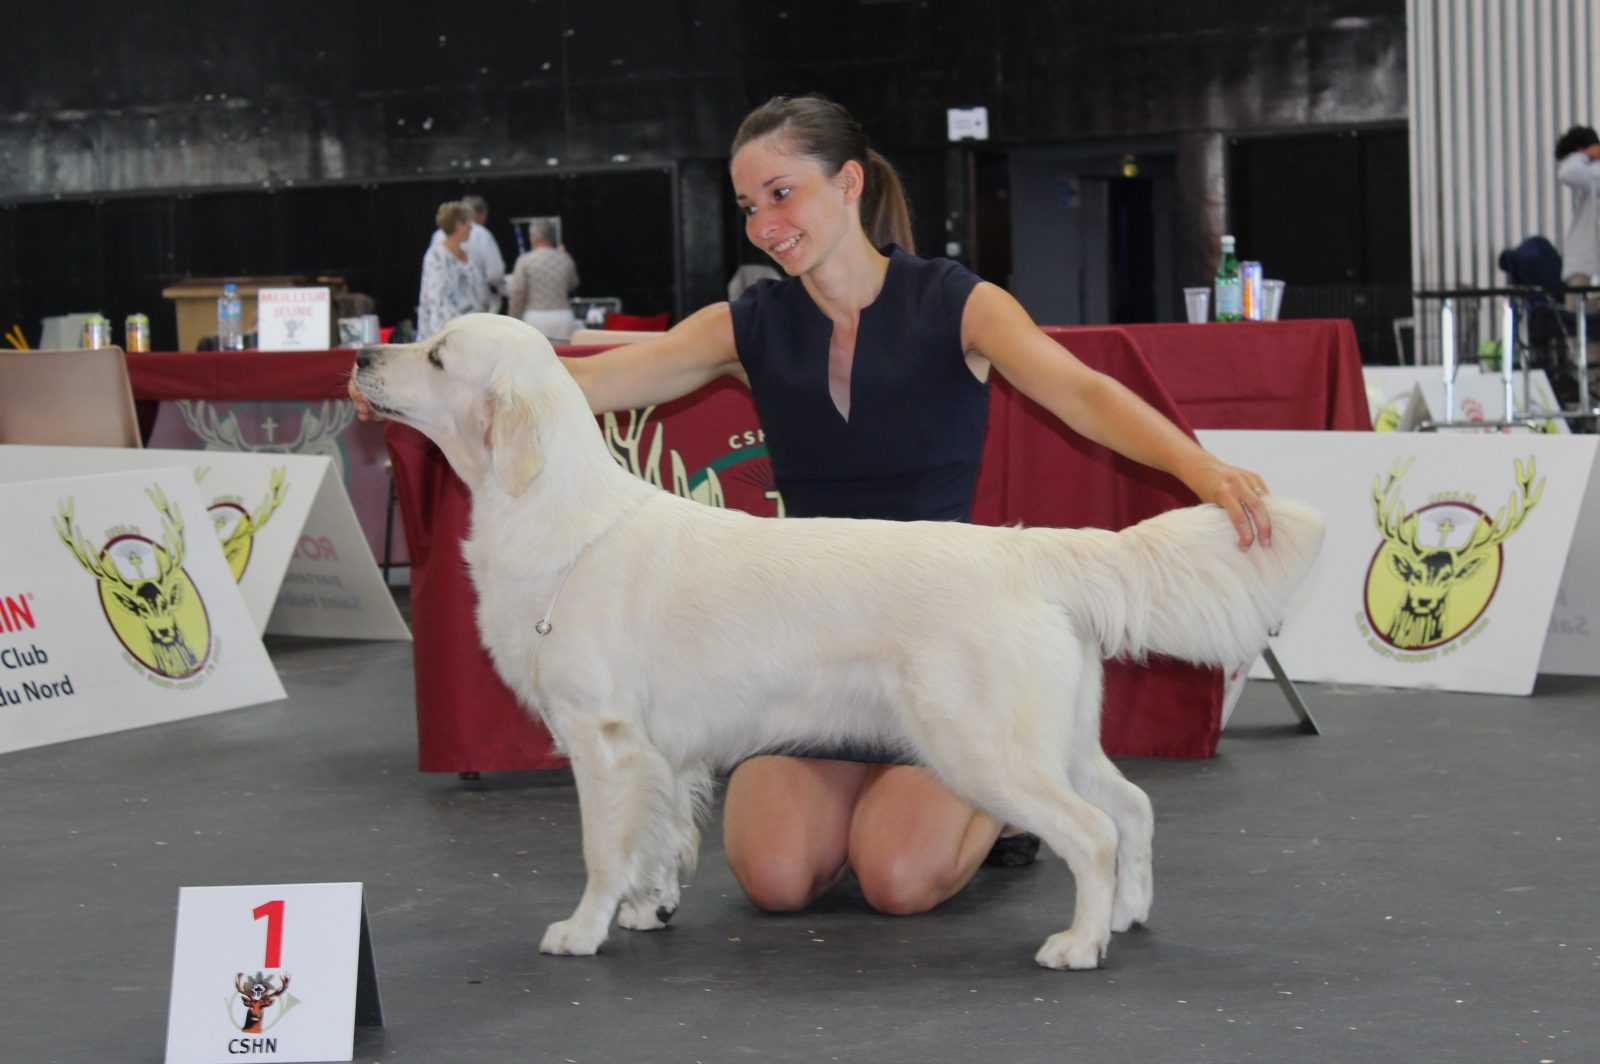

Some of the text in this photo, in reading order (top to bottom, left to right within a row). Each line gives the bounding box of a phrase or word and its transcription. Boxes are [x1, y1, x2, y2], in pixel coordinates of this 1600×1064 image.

[0, 594, 35, 633] IN
[1, 644, 48, 669] Club
[22, 674, 75, 701] Nord
[252, 900, 286, 968] 1
[228, 1037, 278, 1055] CSHN
